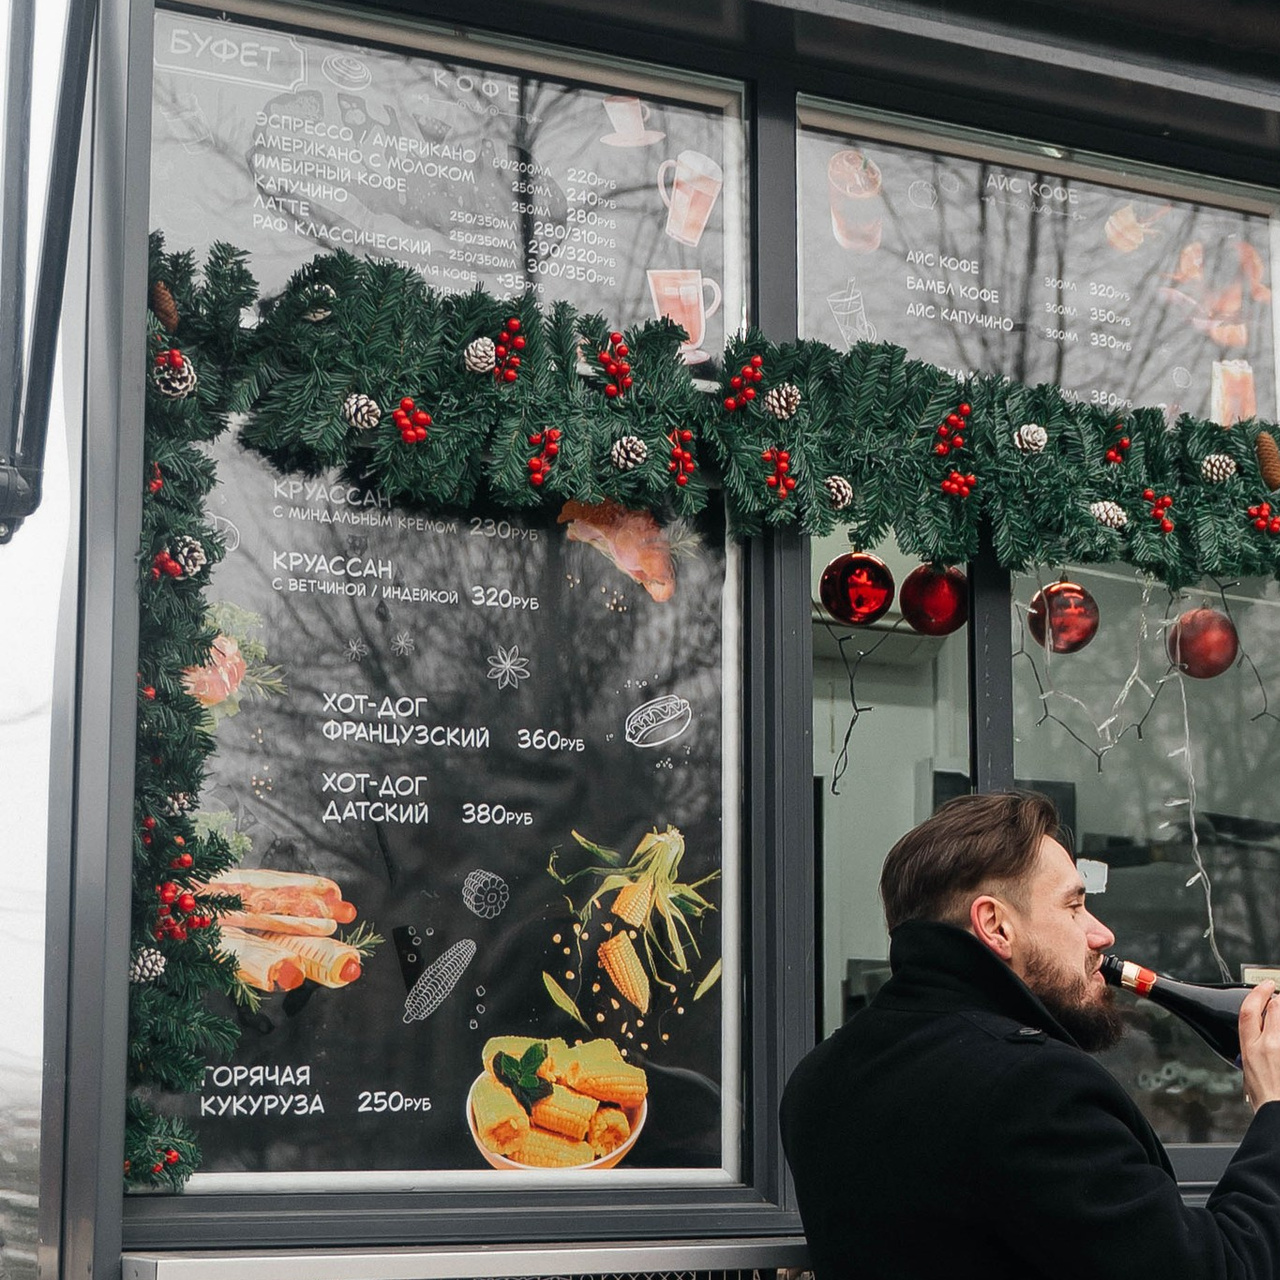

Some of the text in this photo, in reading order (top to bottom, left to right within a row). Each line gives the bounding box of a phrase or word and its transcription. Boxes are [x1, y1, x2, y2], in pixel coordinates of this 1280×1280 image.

[170, 28, 280, 71] БУФЕТ
[433, 69, 520, 102] КОФЕ
[255, 111, 353, 141] ЭСПРЕССО
[373, 133, 476, 163] АМЕРИКАНО
[567, 168, 617, 190] 220РУБ
[255, 133, 617, 209] АМЕРИКАНО С МОЛОКОМ 250МЛ 240РУБ
[254, 154, 617, 229] ИМБИРНЫЙ КОФЕ 250МЛ 280РУБ
[986, 173, 1080, 205] АЙС КОФЕ
[254, 173, 616, 248] КАПУЧИНО 250/350МЛ 280/310РУБ
[253, 195, 616, 268] ЛАТТЕ 250/350МЛ 290/320РУБ
[252, 214, 616, 286] РАФ КЛАССИЧЕСКИЙ 250/350МЛ 300/350РУБ
[443, 268, 478, 282] КОФЕ
[496, 274, 545, 293] +35РУБ
[905, 249, 1132, 302] АЙС КОФЕ 300МЛ 320РУБ
[906, 275, 1132, 327] БАМБЛ КОФЕ 300МЛ 350РУБ
[906, 302, 1132, 352] АЙС КАПУЧИНО 300МЛ 330РУБ
[273, 480, 391, 509] КРУАССАН
[273, 505, 539, 541] С МИНДАЛЬНЫМ КРЕМОМ 230РУБ
[273, 551, 392, 579] КРУАССАН
[272, 577, 283, 590] С
[288, 578, 367, 597] ВЕТЧИНОЙ
[382, 585, 459, 604] ИНДЕЙКОЙ
[471, 585, 540, 610] 320РУБ
[322, 692, 428, 719] ХОТ-ДОГ
[322, 719, 586, 752] ФРАНЦУЗСКИЙ 360РУБ
[322, 772, 428, 798] ХОТ-ДОГ
[322, 800, 533, 826] ДАТСКИЙ 380РУБ
[201, 1065, 311, 1087] ГОРЯЧАЯ
[201, 1090, 432, 1117] КУКУРУЗА 250РУБ
